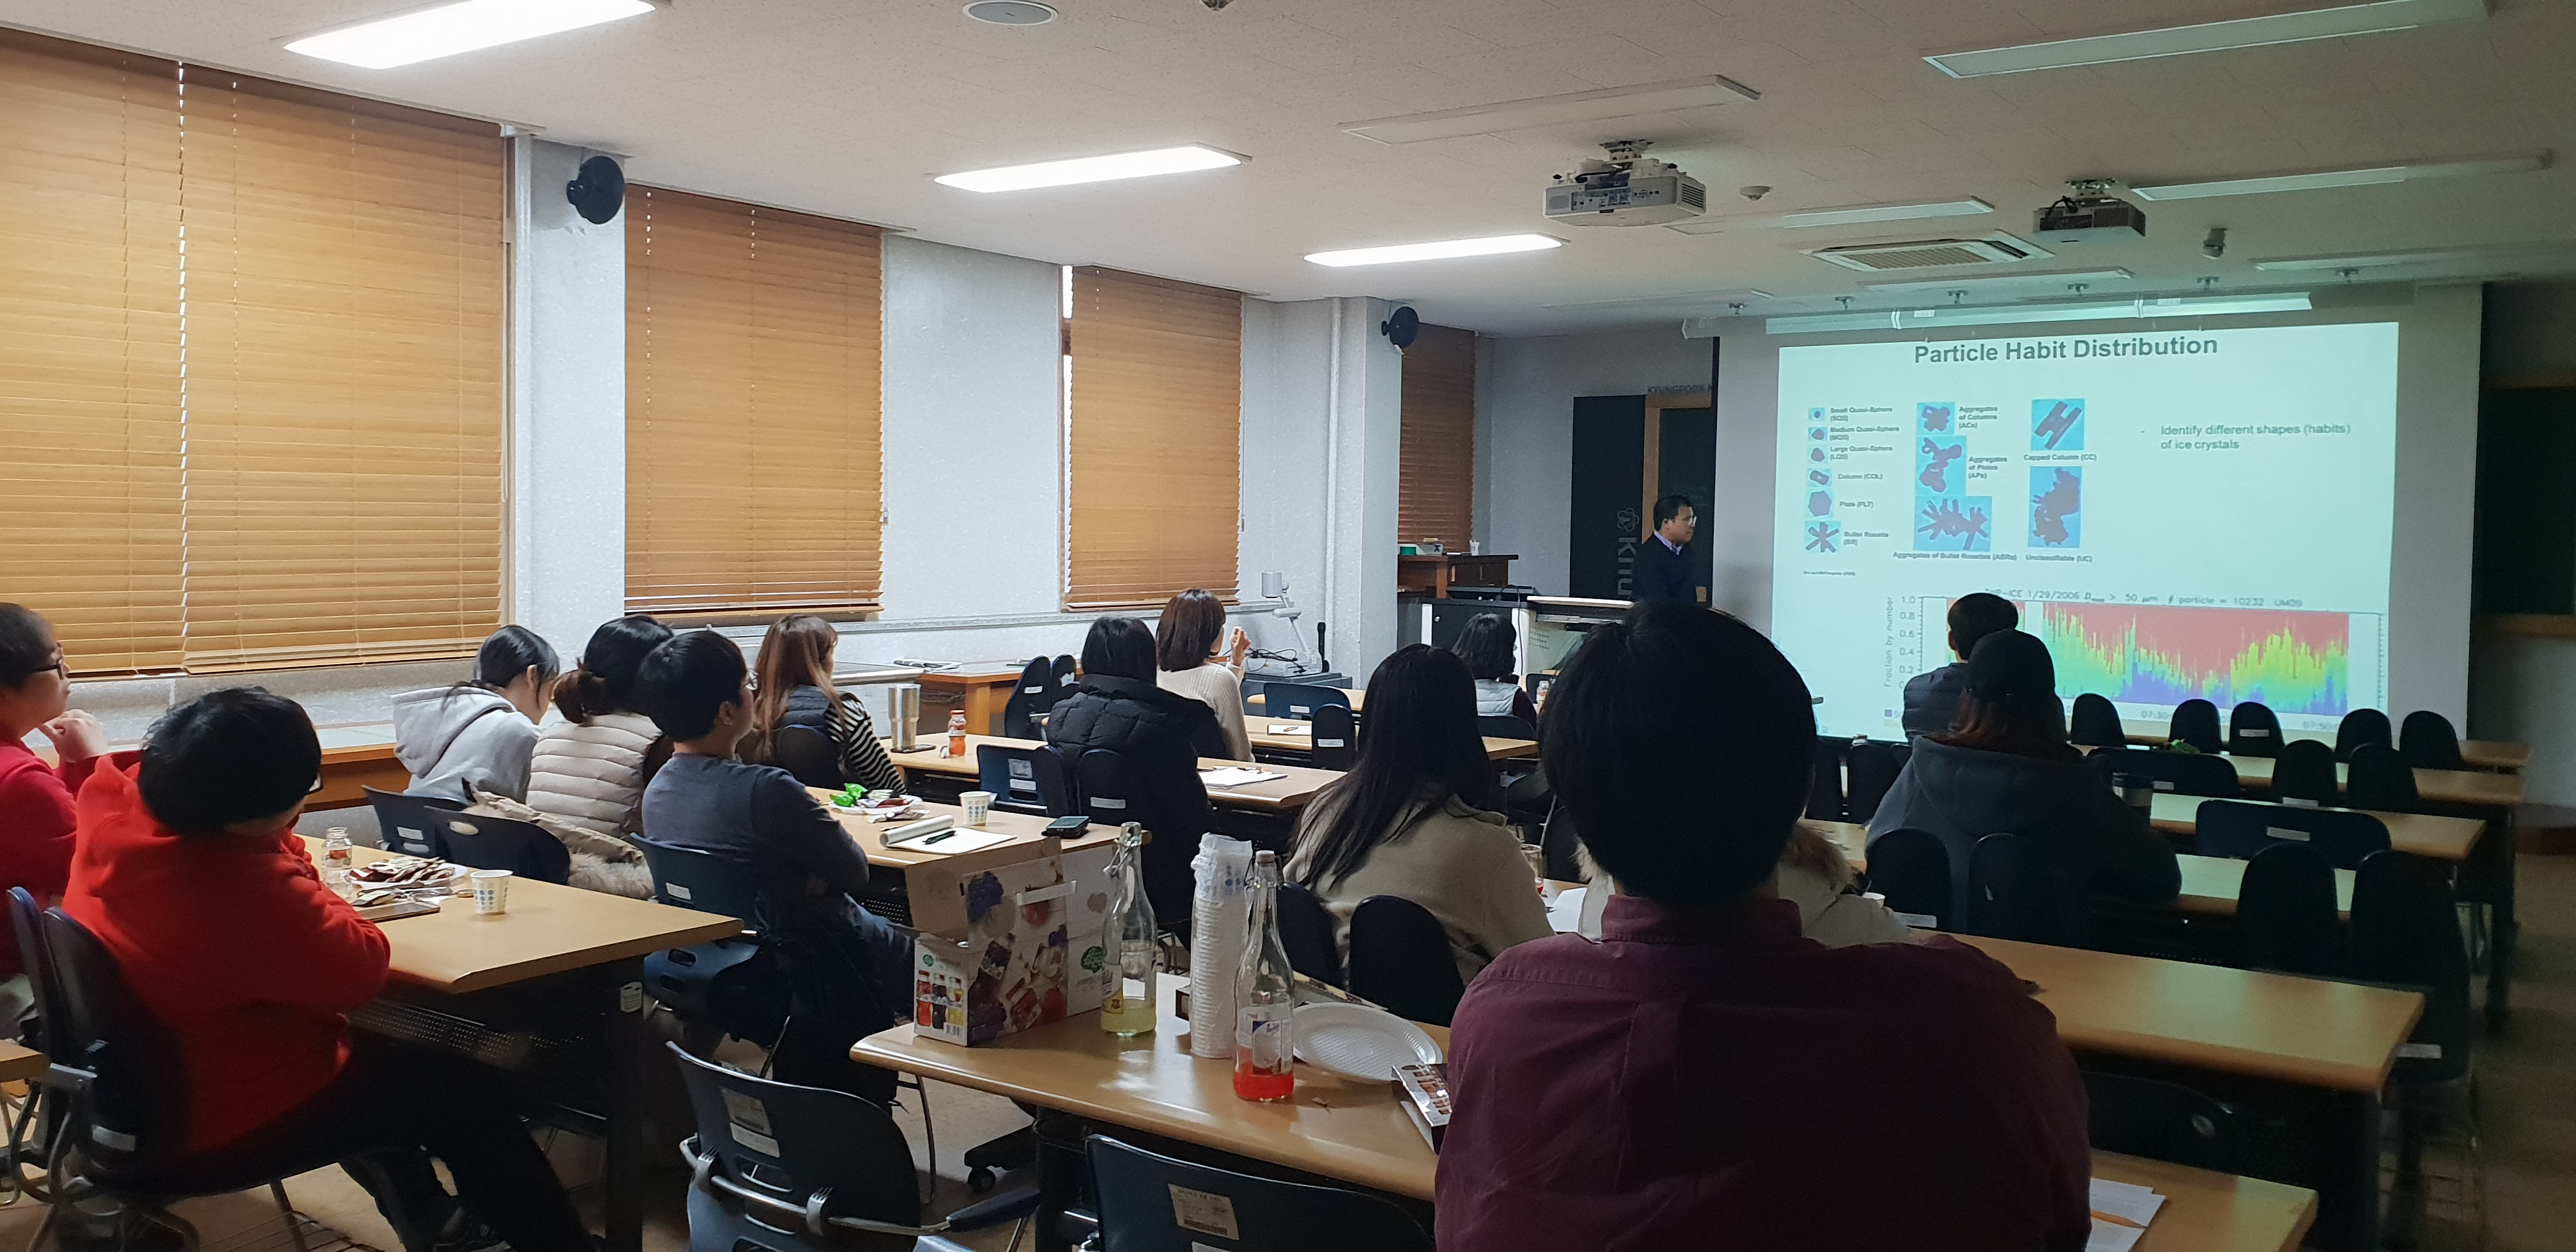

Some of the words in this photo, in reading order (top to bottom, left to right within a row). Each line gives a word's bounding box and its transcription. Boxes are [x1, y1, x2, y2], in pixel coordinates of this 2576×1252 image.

[1915, 344, 1998, 363] Particle
[2006, 341, 2067, 360] Habit
[2074, 336, 2218, 358] Distribution
[2161, 425, 2202, 436] Identify
[2205, 425, 2254, 435] different
[2257, 425, 2301, 436] shapes
[2303, 424, 2351, 436] (habits)
[2161, 439, 2172, 449] of
[2175, 440, 2192, 449] ice
[2195, 439, 2239, 451] crystals
[1901, 596, 1915, 604] 1.0
[2028, 590, 2080, 600] 1/29/2006
[2126, 593, 2138, 602] 50
[2179, 596, 2215, 605] particle
[1900, 612, 1915, 620] 0.8
[1885, 636, 1894, 646] by
[1899, 648, 1914, 656] 0.4
[1884, 650, 1893, 688] Fraction
[1899, 666, 1913, 674] 0.2
